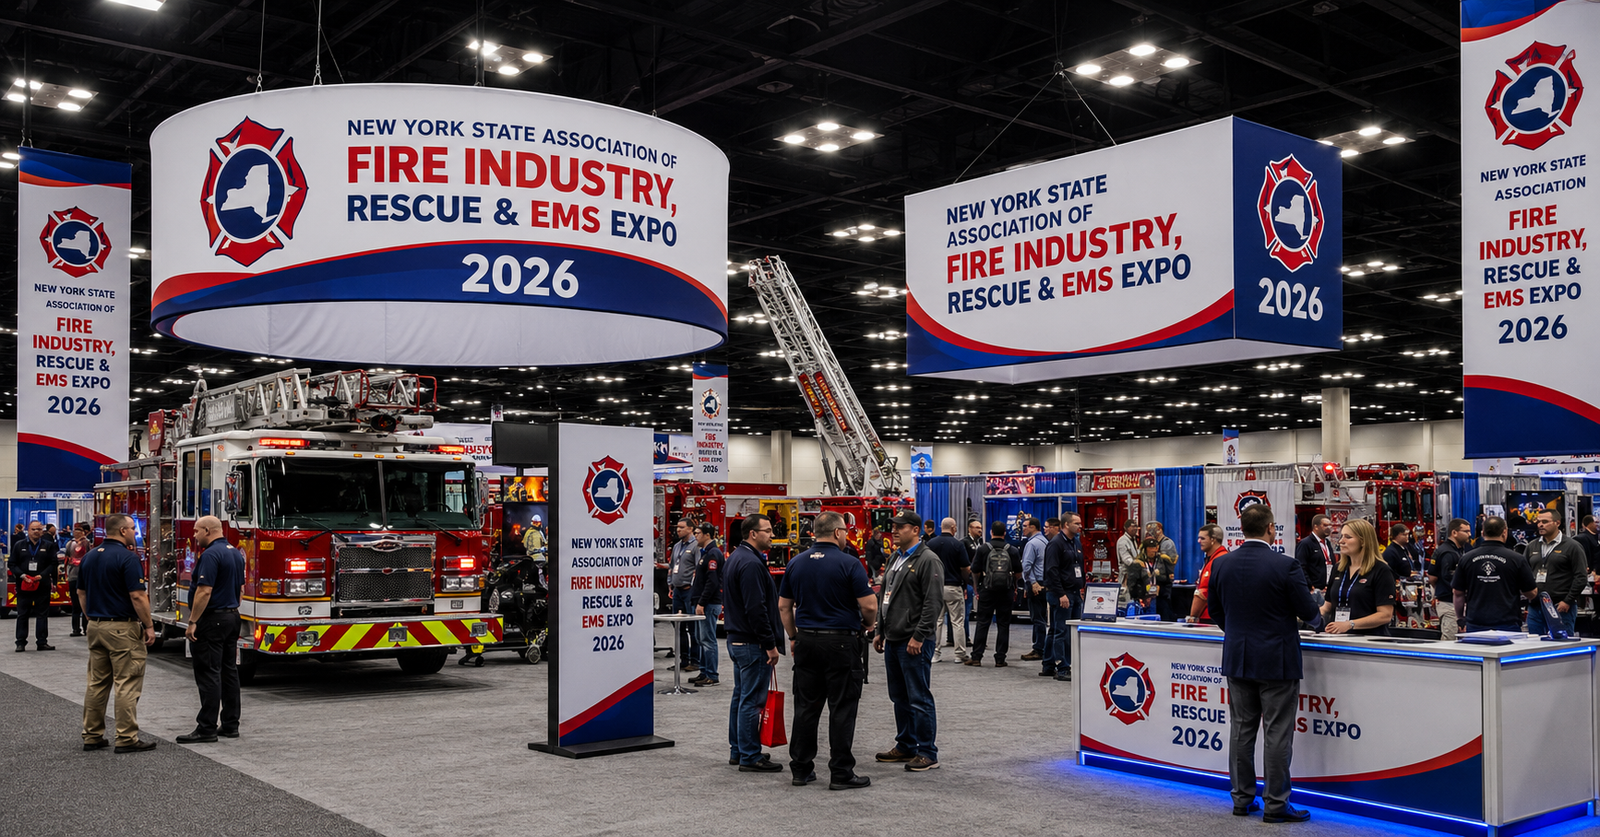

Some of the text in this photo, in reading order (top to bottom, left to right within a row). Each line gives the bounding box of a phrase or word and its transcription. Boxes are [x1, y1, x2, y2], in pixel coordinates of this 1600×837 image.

[348, 119, 677, 169] NEW YORK STATE ASSOCIATION OF
[1481, 154, 1586, 183] NEW YORK STATE
[348, 146, 677, 218] FIRE INDUSTRY,
[1495, 176, 1586, 201] ASSOCIATION
[947, 174, 1107, 225] NEW YORK STATE
[348, 194, 677, 247] RESCUE & EMS EXPO
[947, 204, 1093, 248] ASSOCIATION OF
[1509, 204, 1557, 230] FIRE
[947, 212, 1182, 284] FIRE INDUSTRY,
[1480, 228, 1587, 260] INDUSTRY,
[462, 253, 579, 298] 2026
[1484, 257, 1581, 285] RESCUE &
[34, 283, 115, 299] NEW YORK STATE
[948, 254, 1191, 314] RESCUE & EMS EXPO
[1484, 282, 1581, 309] EMS EXPO
[46, 300, 115, 313] ASSOCIATION OF
[1259, 277, 1323, 321] 2026
[57, 317, 92, 334] FIRE
[1499, 314, 1567, 344] 2026
[33, 334, 115, 357] INDUSTRY,
[36, 355, 110, 372] RESCUE &
[36, 373, 110, 389] EMS EXPO
[48, 396, 101, 415] 2026
[572, 538, 643, 549] NEW YORK STATE
[572, 556, 643, 568] ASSOCIATION OF
[595, 575, 644, 590] INDUSTRY,
[583, 594, 633, 609] RESCUE &
[582, 613, 633, 628] EMS EXPO
[593, 635, 624, 652] 2026
[1171, 662, 1186, 670] NEW
[1187, 664, 1205, 672] YORK
[1171, 683, 1208, 702] FIRE
[1172, 704, 1226, 724] RESCUE
[1172, 726, 1223, 751] 2026
[1313, 719, 1361, 740] EXPO
